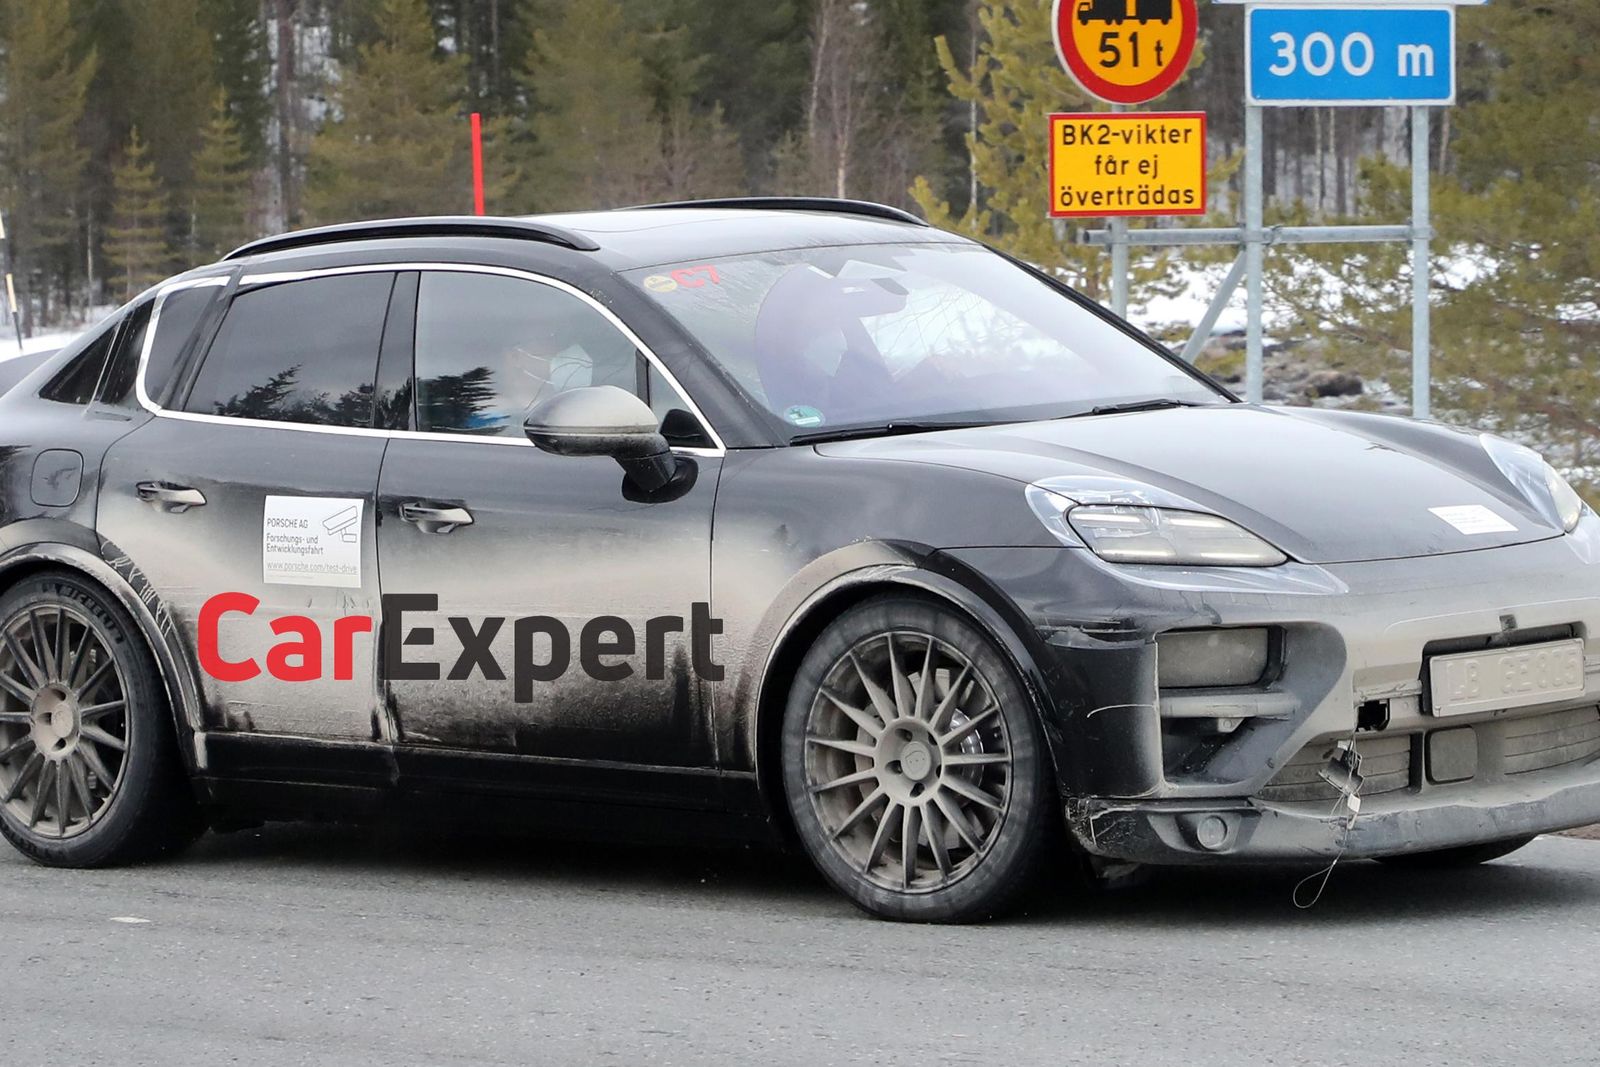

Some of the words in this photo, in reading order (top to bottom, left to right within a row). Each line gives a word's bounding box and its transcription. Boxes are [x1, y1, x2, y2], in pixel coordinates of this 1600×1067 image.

[1099, 32, 1139, 68] 51
[1155, 40, 1163, 67] t
[1269, 31, 1375, 77] 300
[1397, 43, 1435, 77] m
[1062, 124, 1192, 146] BK2-vikter
[1095, 155, 1130, 176] får
[1138, 155, 1158, 179] ej
[1060, 184, 1195, 207] överträdas
[266, 518, 297, 528] PORSCHE
[299, 519, 309, 529] AG
[266, 532, 305, 545] Forschungs-
[306, 535, 319, 545] und
[266, 543, 324, 556] Entwicklungsfahrt
